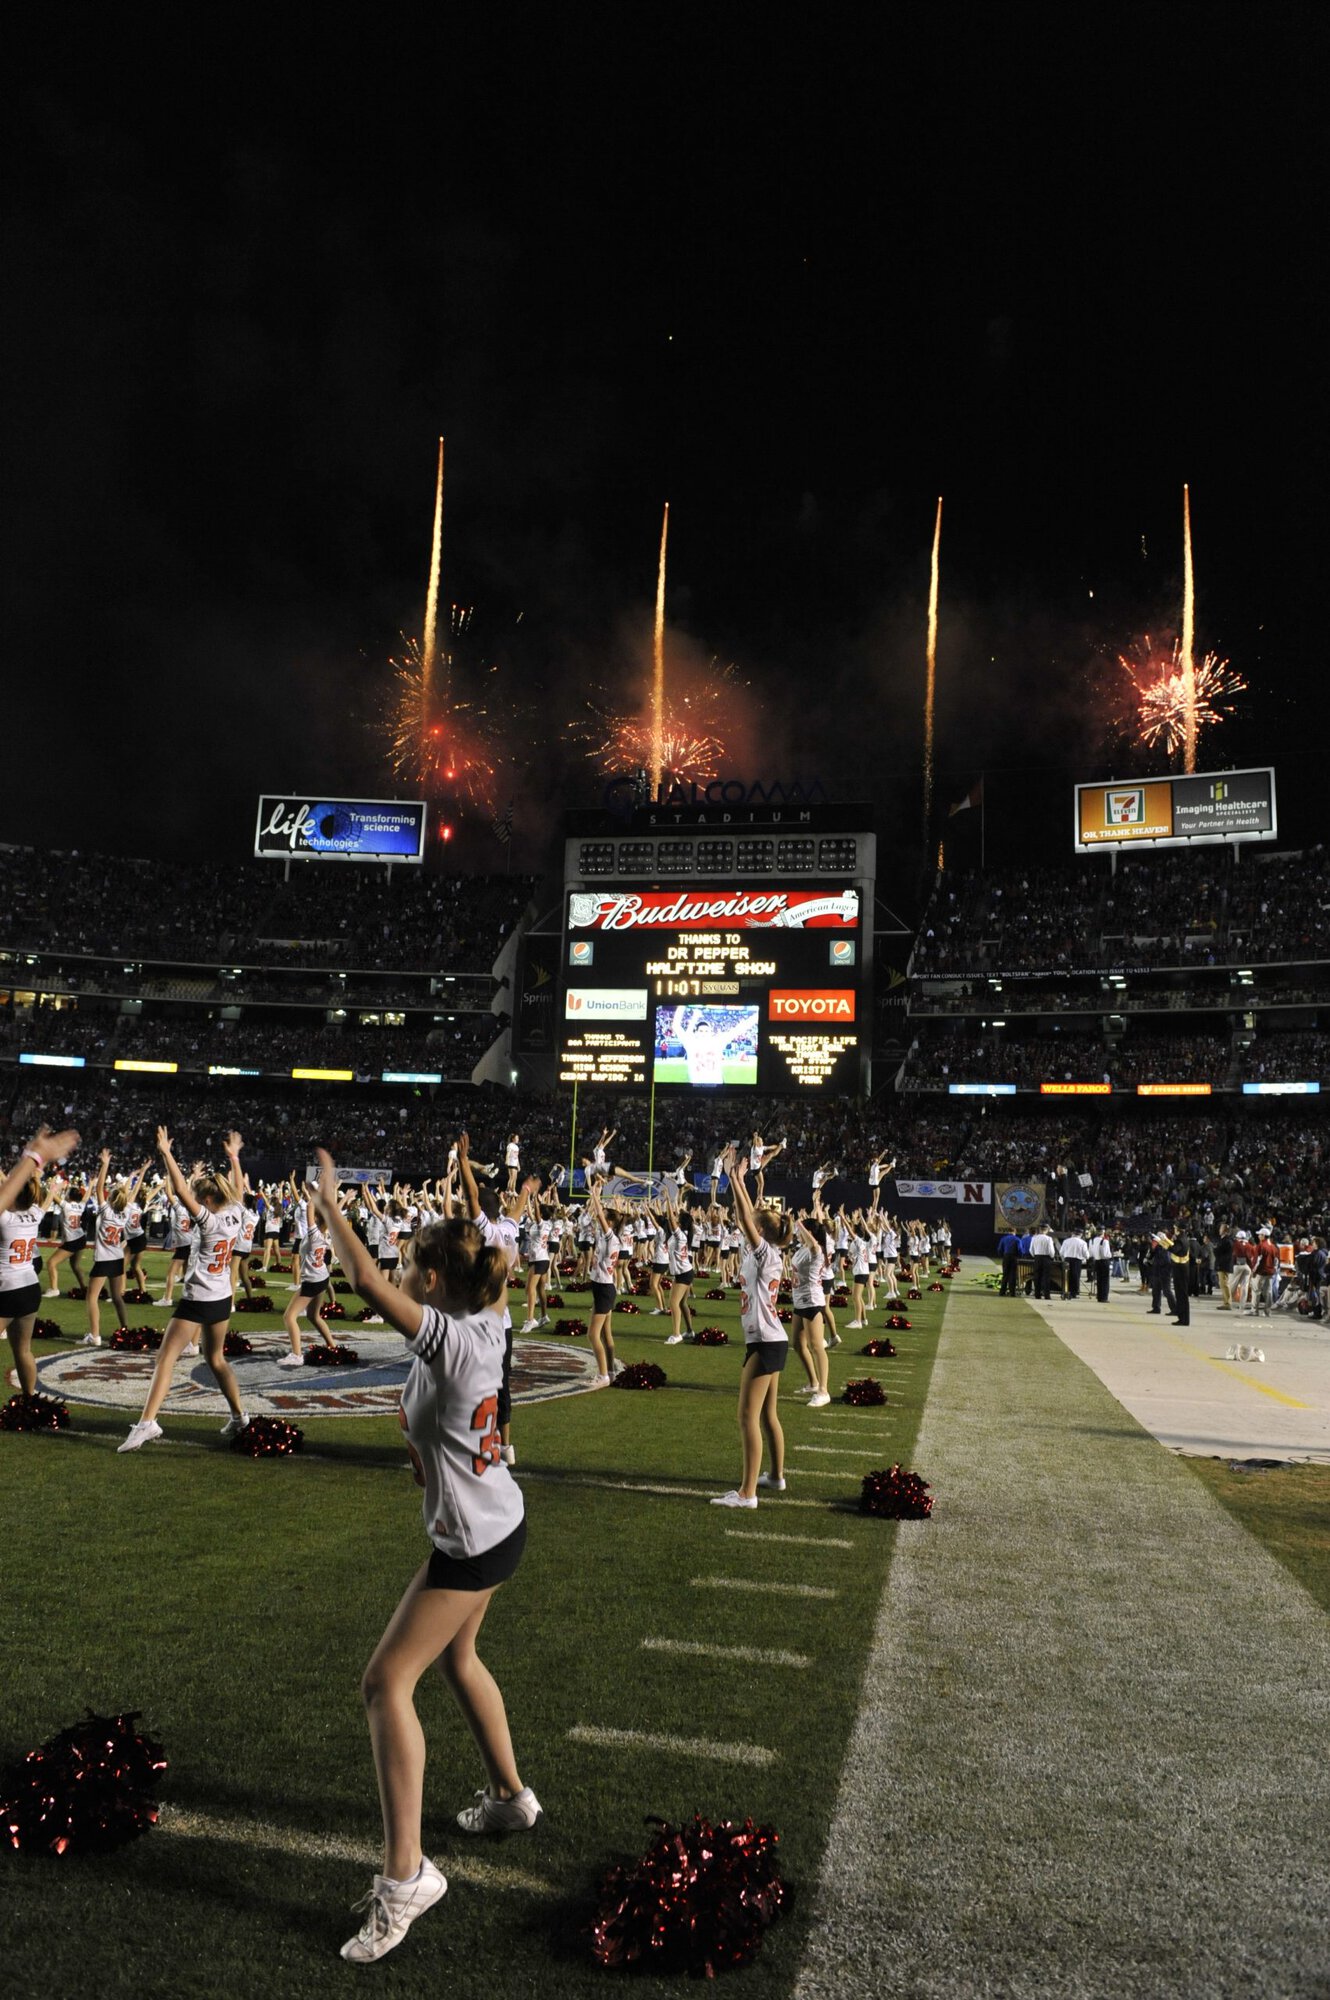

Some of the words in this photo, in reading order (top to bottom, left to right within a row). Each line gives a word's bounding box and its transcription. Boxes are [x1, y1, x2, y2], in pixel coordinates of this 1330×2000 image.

[1176, 804, 1213, 815] Imaging
[1215, 800, 1267, 811] Healthcare
[350, 812, 416, 826] Transforming
[650, 811, 811, 824] STADIUM
[1181, 822, 1196, 830] Your
[1199, 820, 1224, 828] Partner
[1236, 817, 1260, 825] Health
[260, 802, 316, 849] life
[364, 823, 400, 832] science
[1100, 829, 1130, 837] THANK
[594, 892, 788, 930] Budweiser
[789, 904, 829, 921] American
[831, 902, 856, 912] Lager
[679, 934, 721, 944] THANKS
[725, 934, 740, 944] TO
[668, 947, 688, 959] DR
[694, 947, 749, 959] PEPPER
[646, 962, 725, 974] HALFTIME
[735, 962, 776, 974] SHOW
[657, 980, 700, 995] 11:07
[586, 1000, 646, 1010] UnionBank
[773, 998, 851, 1014] TOYOTA
[769, 1036, 786, 1044] THE
[790, 1036, 829, 1044] PACIFIC
[833, 1036, 857, 1045] LIFE
[573, 1063, 595, 1071] HIGH
[599, 1064, 631, 1072] SCHOOL
[1042, 1084, 1075, 1093] WELLS
[1077, 1084, 1109, 1093] FARGO
[964, 1184, 984, 1202] N
